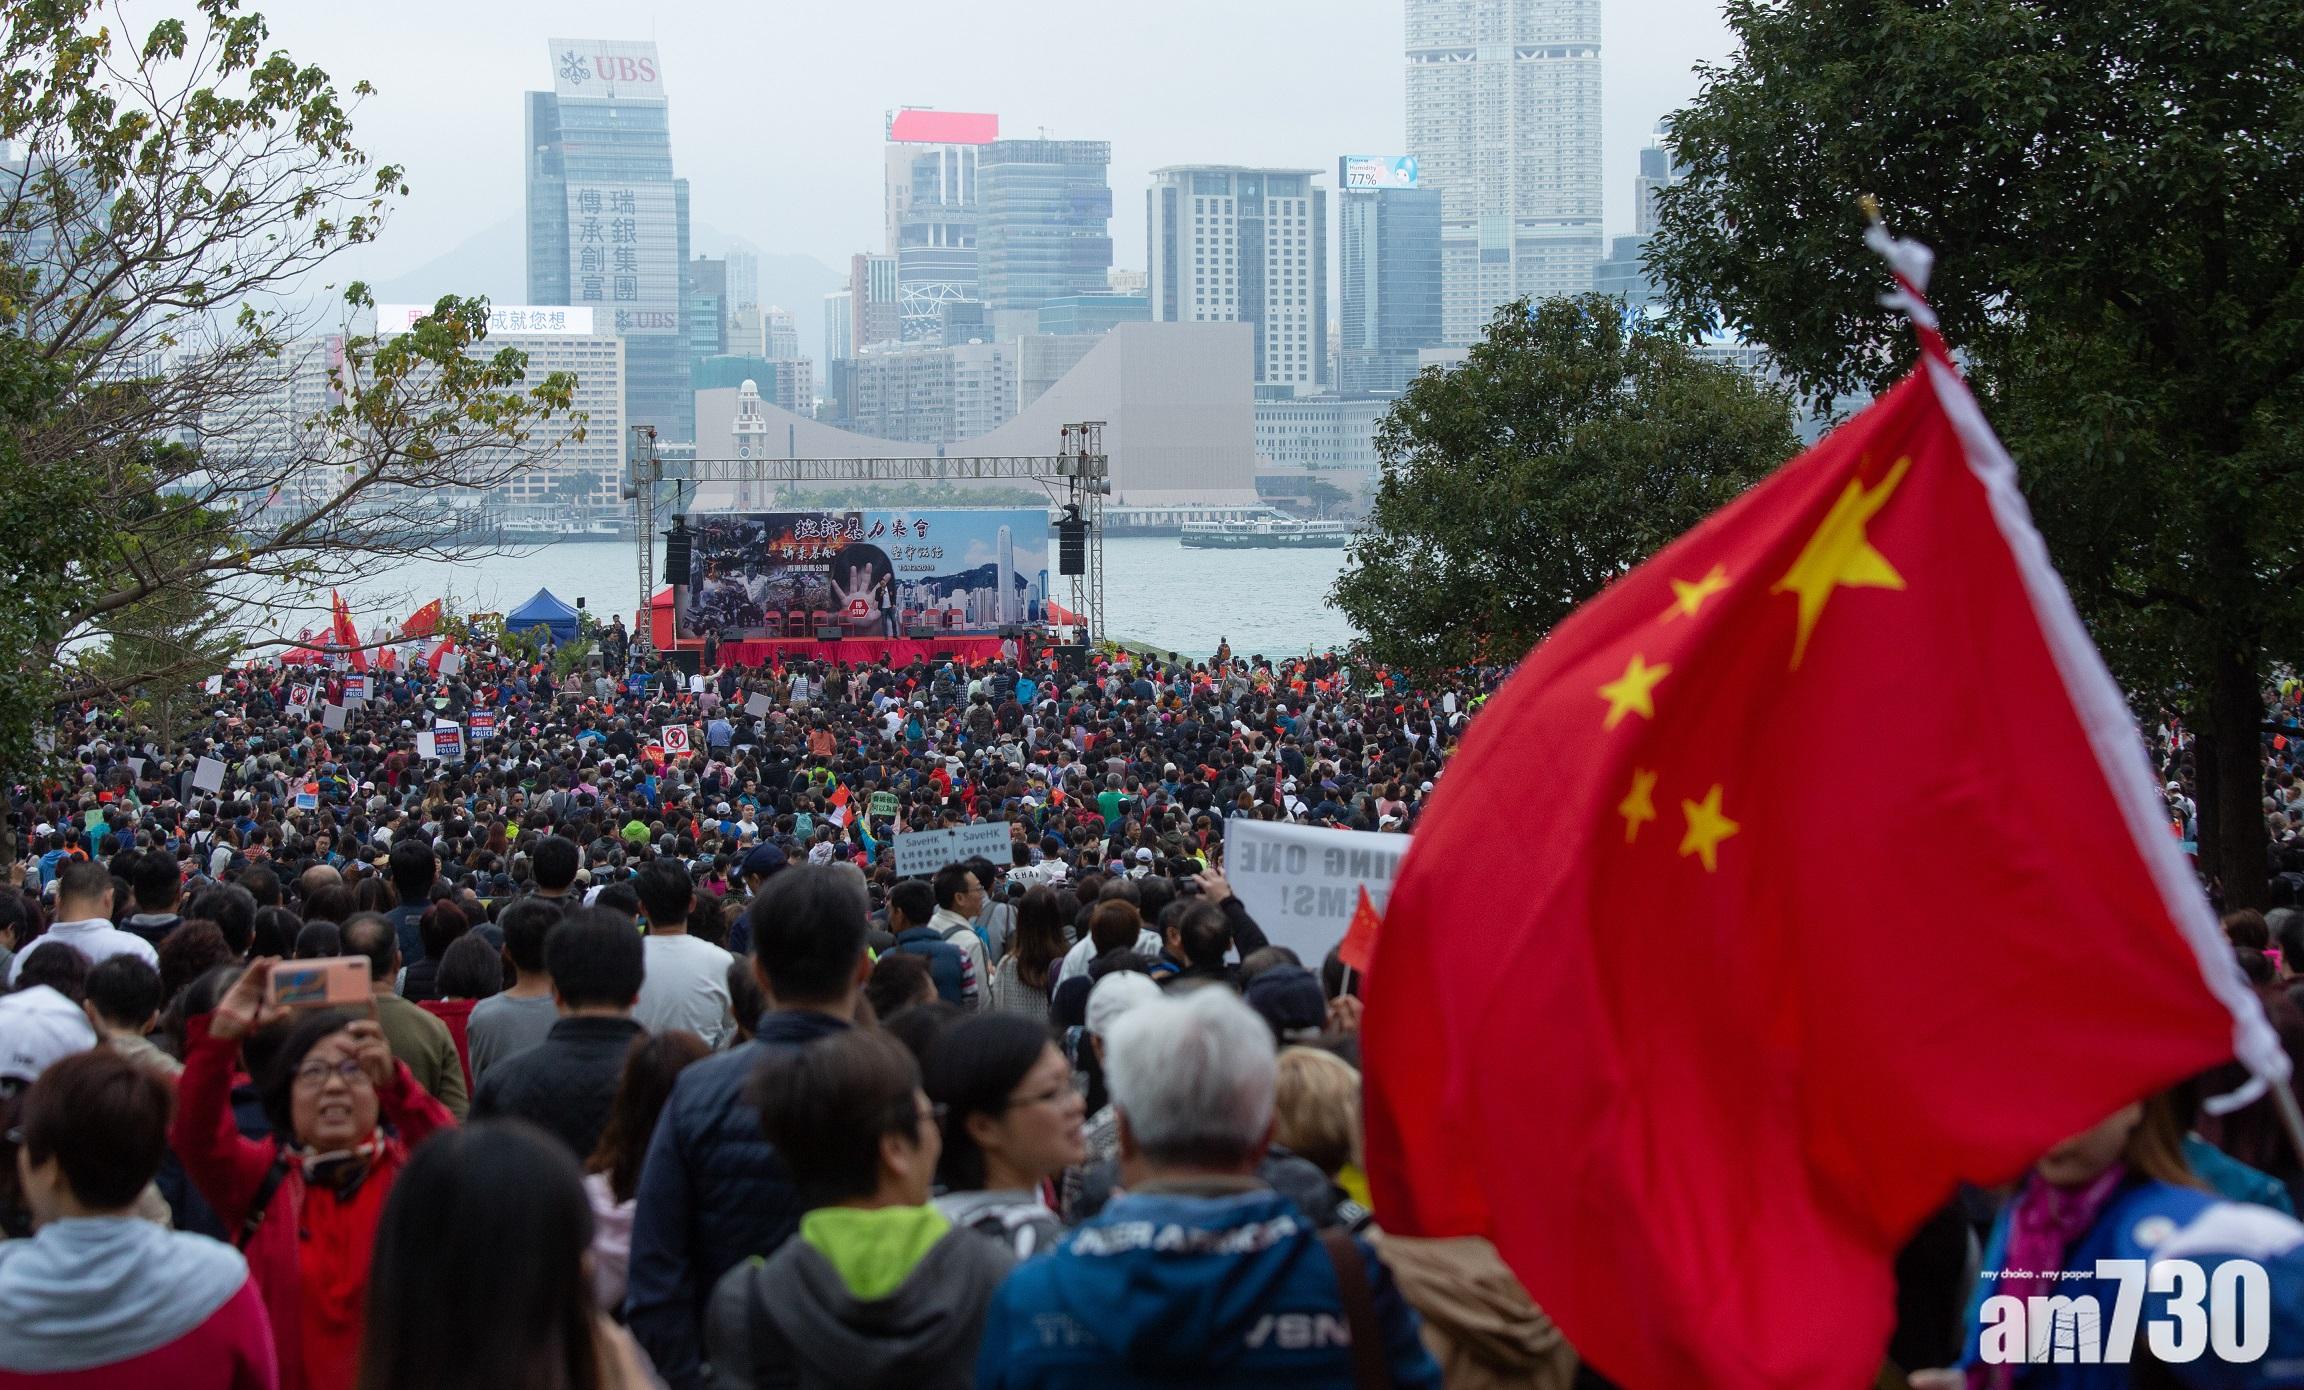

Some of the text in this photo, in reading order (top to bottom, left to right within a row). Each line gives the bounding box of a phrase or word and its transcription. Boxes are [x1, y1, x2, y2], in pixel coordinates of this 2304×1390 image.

[594, 55, 656, 83] UBS
[1350, 173, 1377, 185] 77%
[576, 188, 605, 302] 傳承創富
[610, 189, 639, 303] 瑞銀集團
[490, 310, 567, 331] 成就您想
[635, 312, 675, 329] UBS
[436, 746, 459, 754] POLICE
[906, 835, 940, 848] SaveHK
[963, 828, 1001, 841] SaveHK
